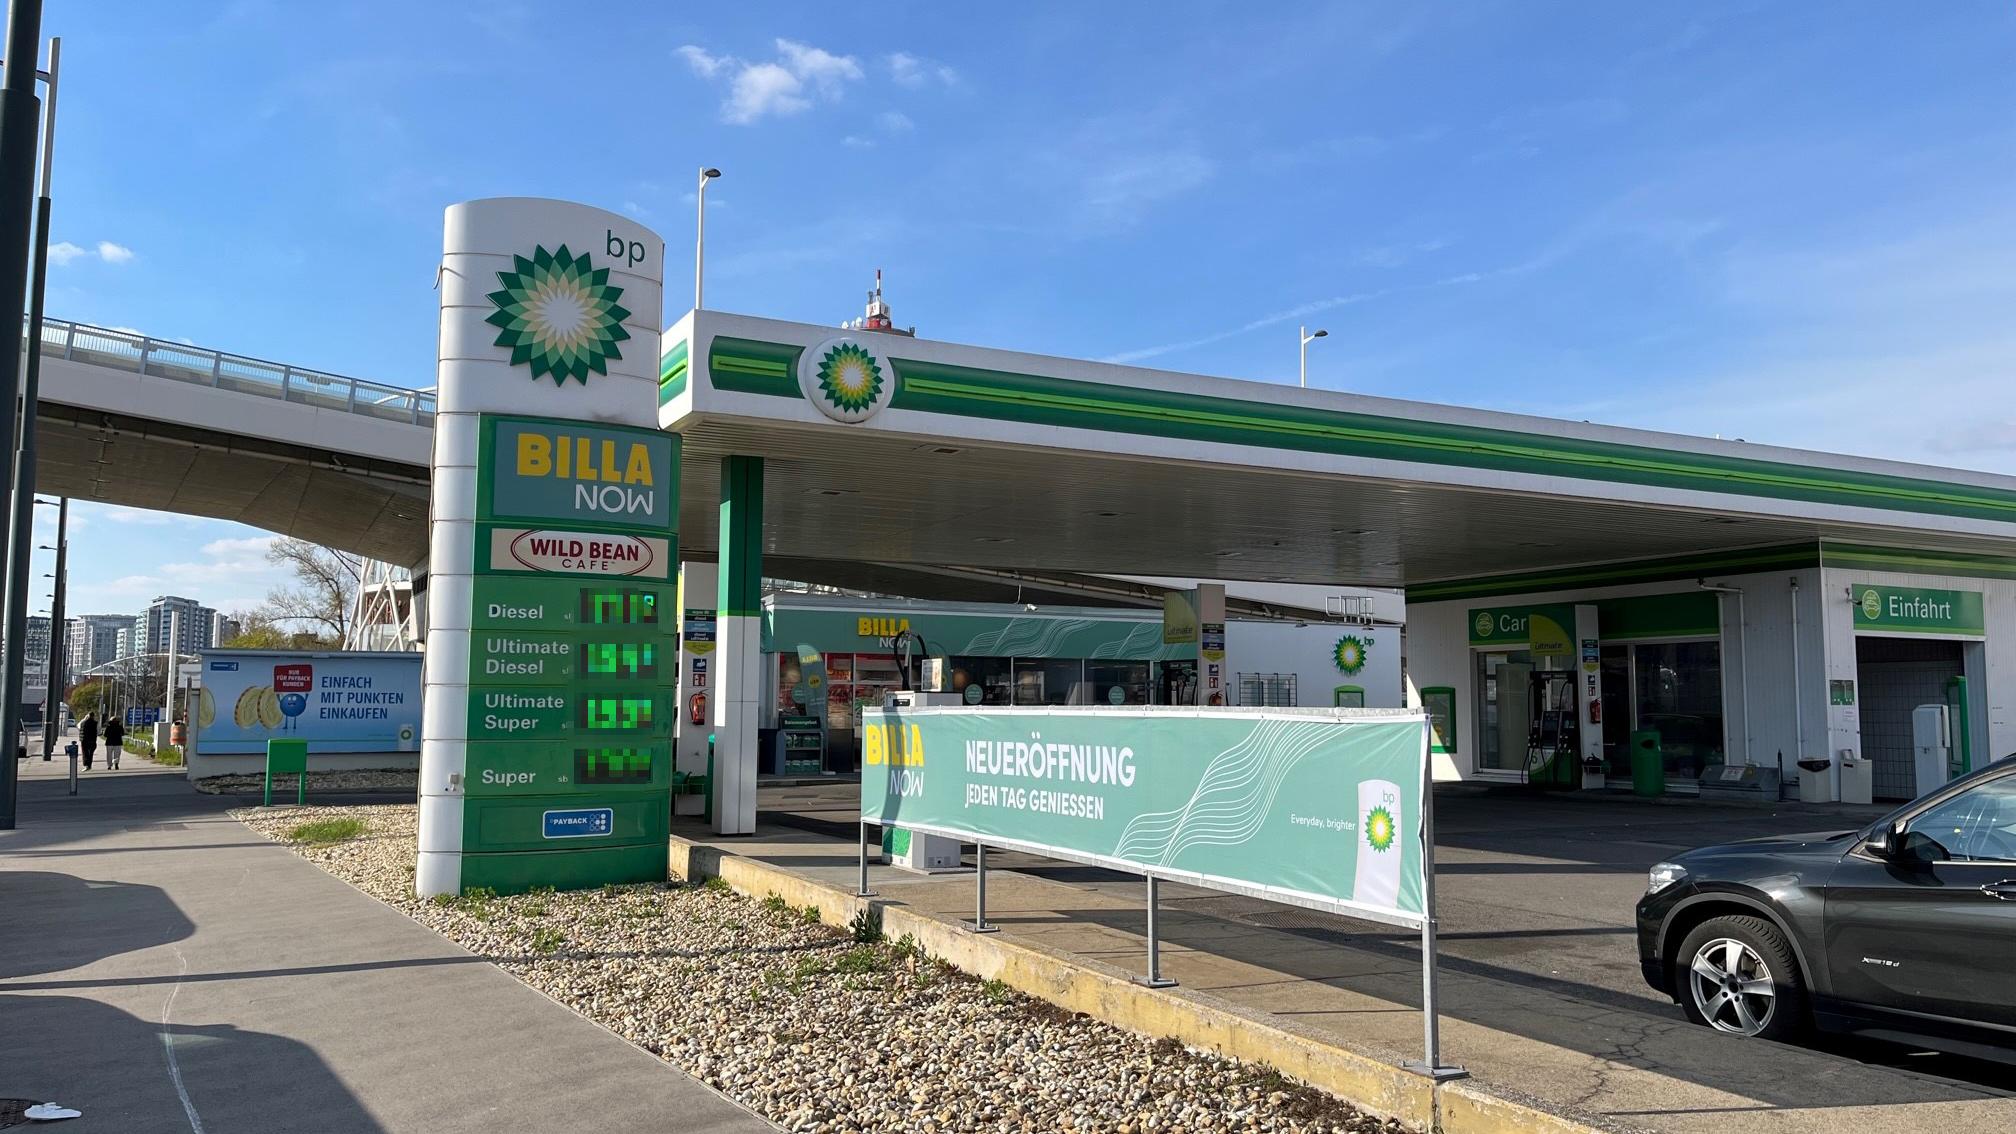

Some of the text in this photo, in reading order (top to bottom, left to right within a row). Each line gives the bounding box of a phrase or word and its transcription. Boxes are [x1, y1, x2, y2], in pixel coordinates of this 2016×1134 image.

[606, 229, 645, 267] bp
[517, 432, 653, 486] BILLA
[575, 484, 653, 515] NOW
[530, 538, 639, 561] WILD BEAN
[488, 604, 543, 619] Diesel
[1889, 596, 1951, 619] Einfahrt
[858, 616, 911, 637] BILLA
[1500, 614, 1527, 632] Car
[486, 638, 569, 655] Ultimate
[1364, 636, 1375, 647] bp
[485, 659, 544, 674] Diesel
[322, 676, 372, 689] EINFACH
[321, 692, 404, 705] MIT PUNKTEN
[485, 694, 564, 708] Ultimate
[320, 707, 388, 720] EINKAUFEN
[484, 715, 539, 732] Super
[866, 724, 925, 767] BILLA
[966, 731, 1136, 787] NEUERÖFFNUNG
[481, 769, 536, 785] Super
[889, 769, 925, 797] NOW
[965, 783, 1104, 820] JEDEN TAG GENIESSEN
[1382, 789, 1395, 805] bp
[553, 817, 588, 825] PAYBACK
[1290, 813, 1356, 832] Everyday, brighter
